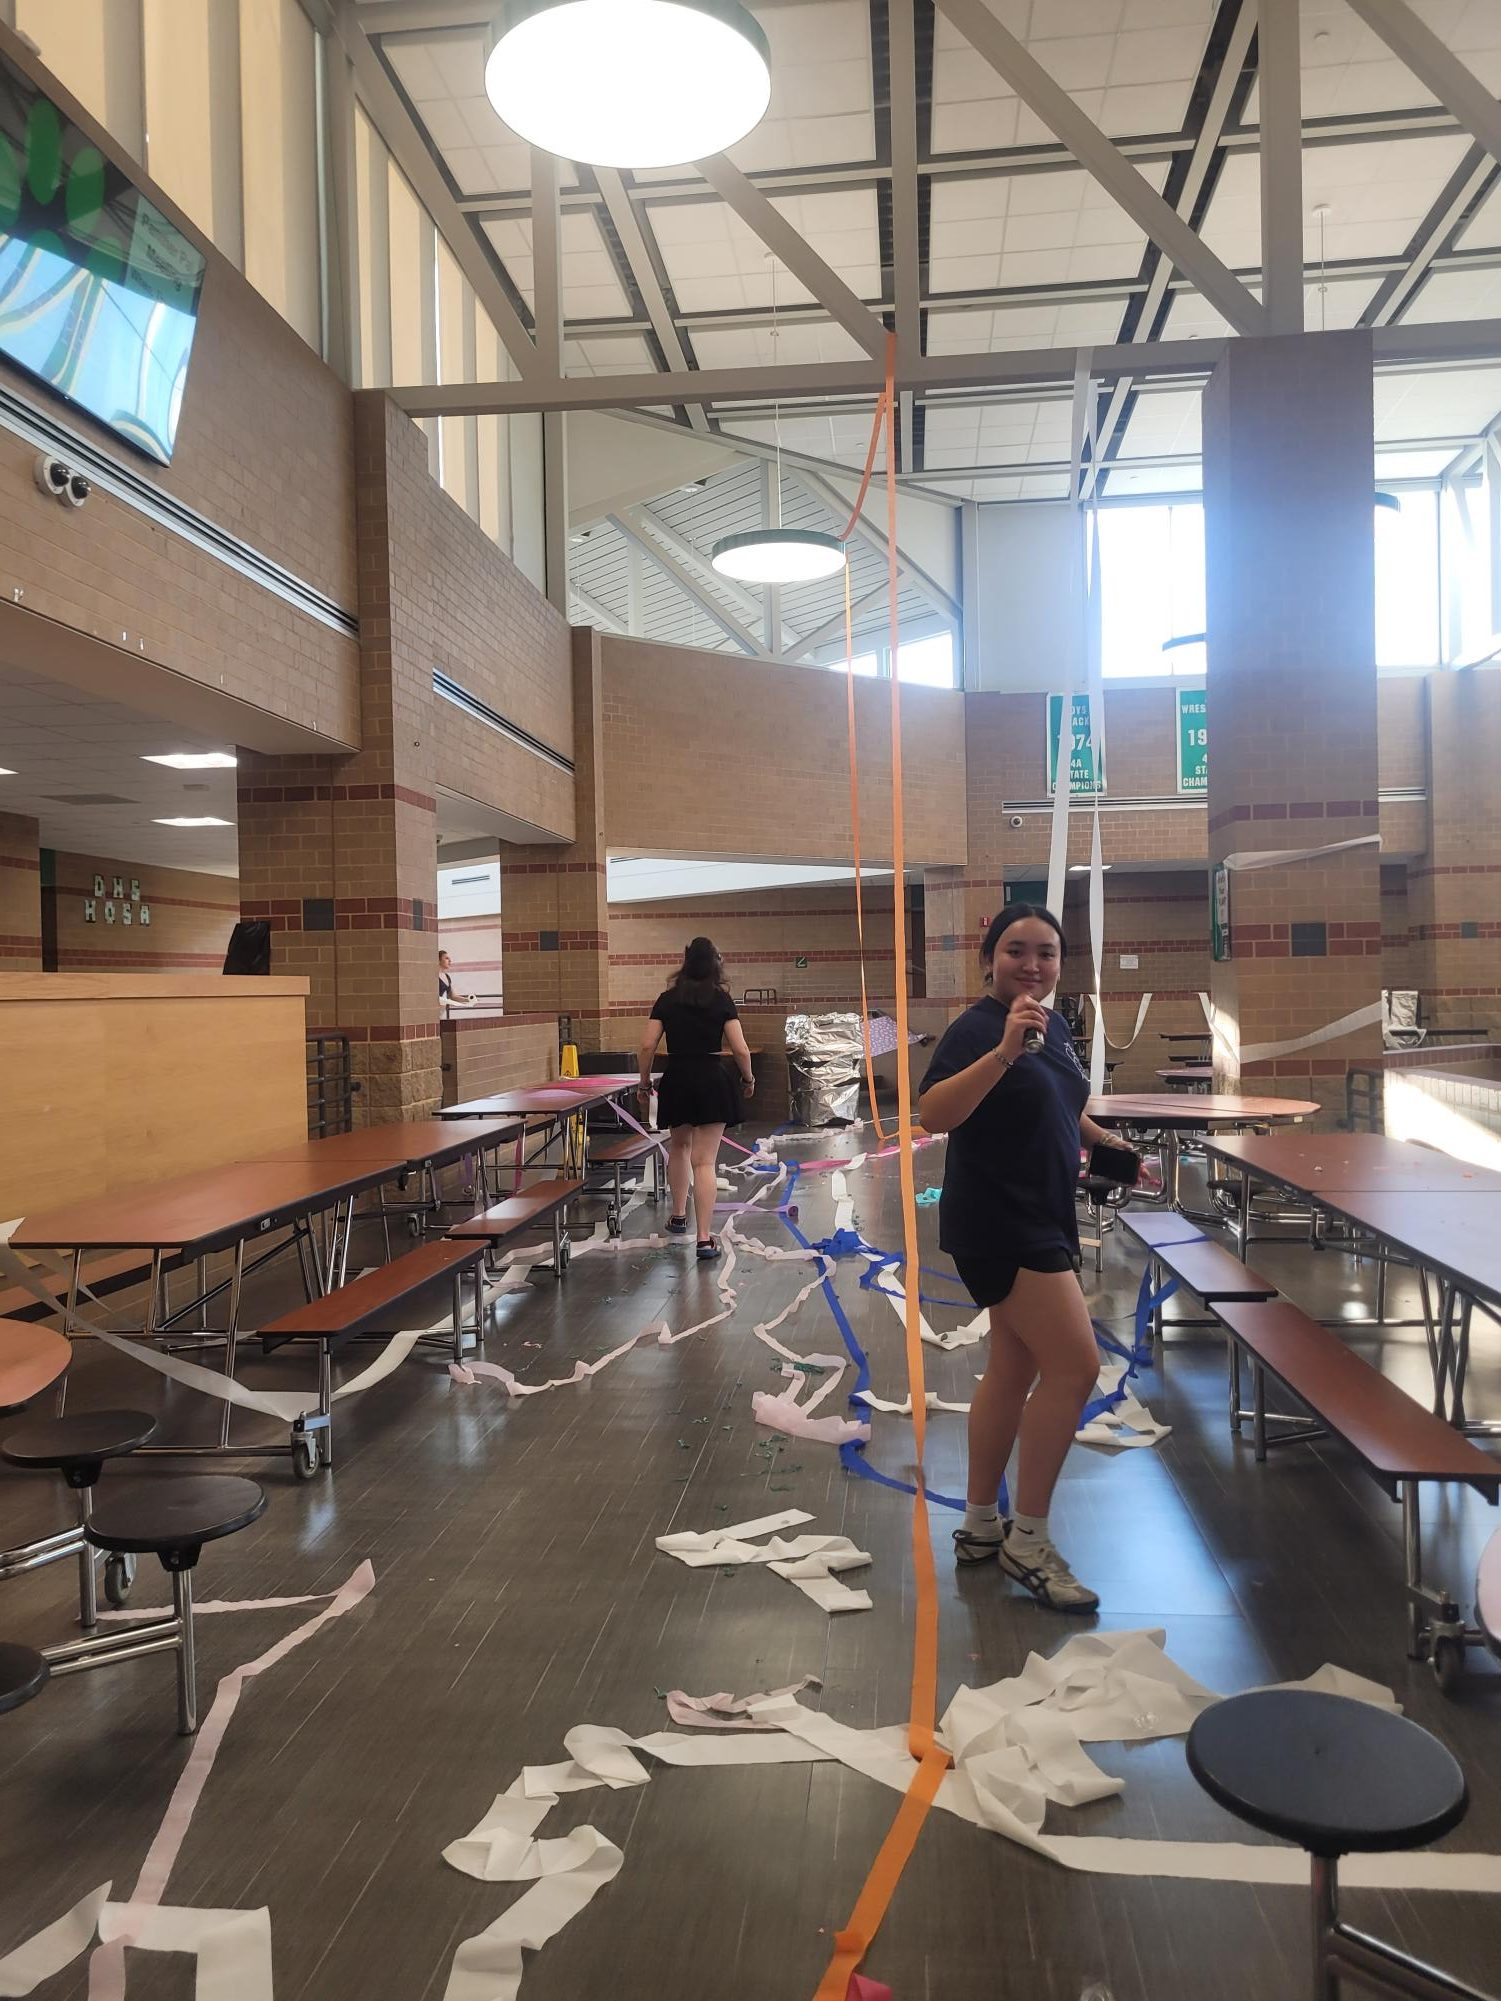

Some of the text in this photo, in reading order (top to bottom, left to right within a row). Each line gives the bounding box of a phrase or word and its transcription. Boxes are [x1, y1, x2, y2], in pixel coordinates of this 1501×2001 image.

[1070, 770, 1089, 779] TATE
[1195, 766, 1207, 775] ST
[1052, 781, 1101, 791] CMPIONS
[94, 875, 140, 901] DHS
[85, 900, 150, 925] HOSA
